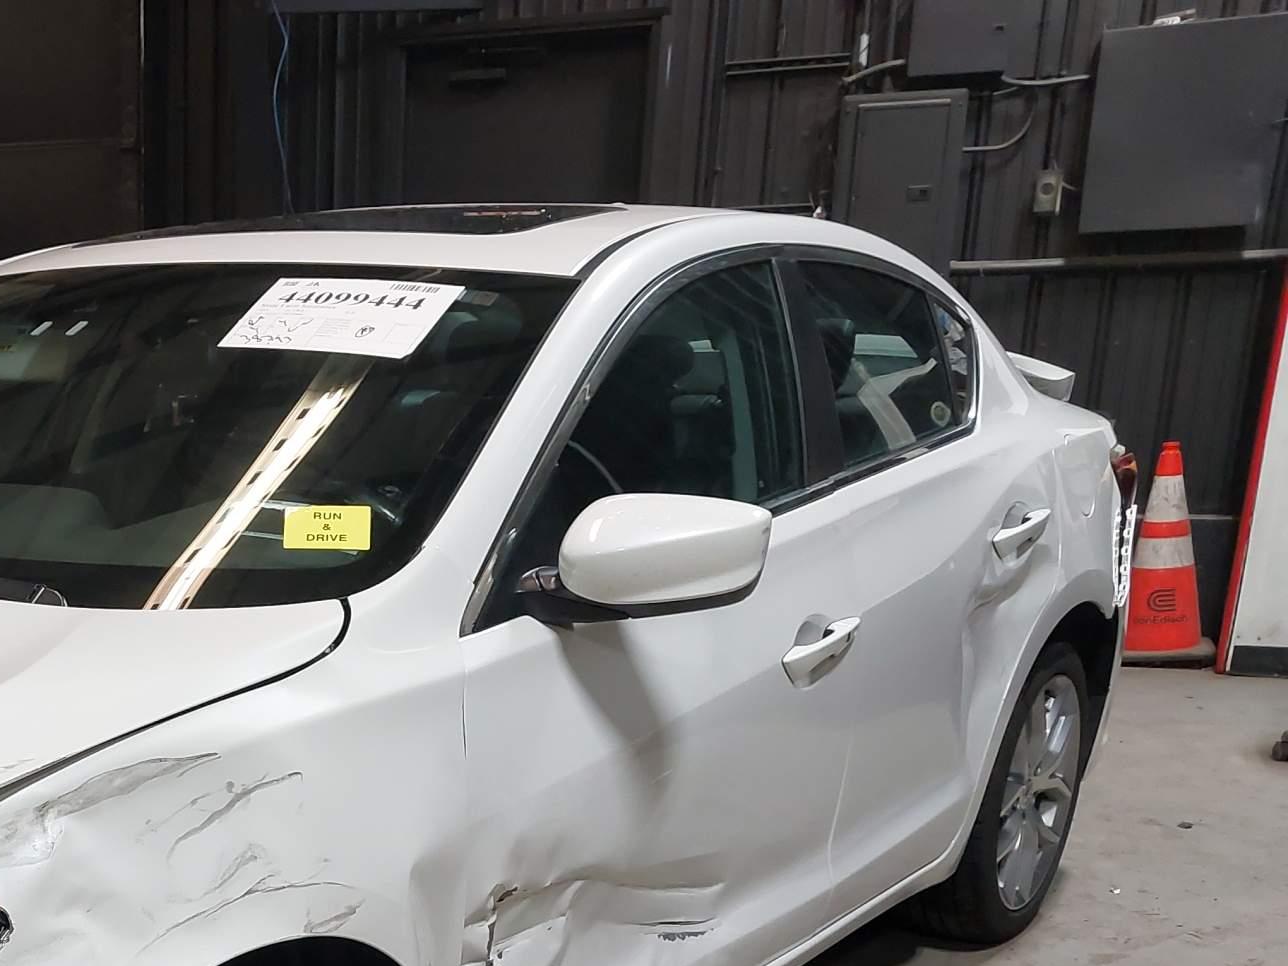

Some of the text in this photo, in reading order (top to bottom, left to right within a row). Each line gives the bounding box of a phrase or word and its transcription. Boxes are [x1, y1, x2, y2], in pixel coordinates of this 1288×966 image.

[278, 290, 427, 311] 44099444
[313, 511, 342, 520] RUN
[322, 523, 332, 531] &
[306, 533, 348, 542] DRIVE
